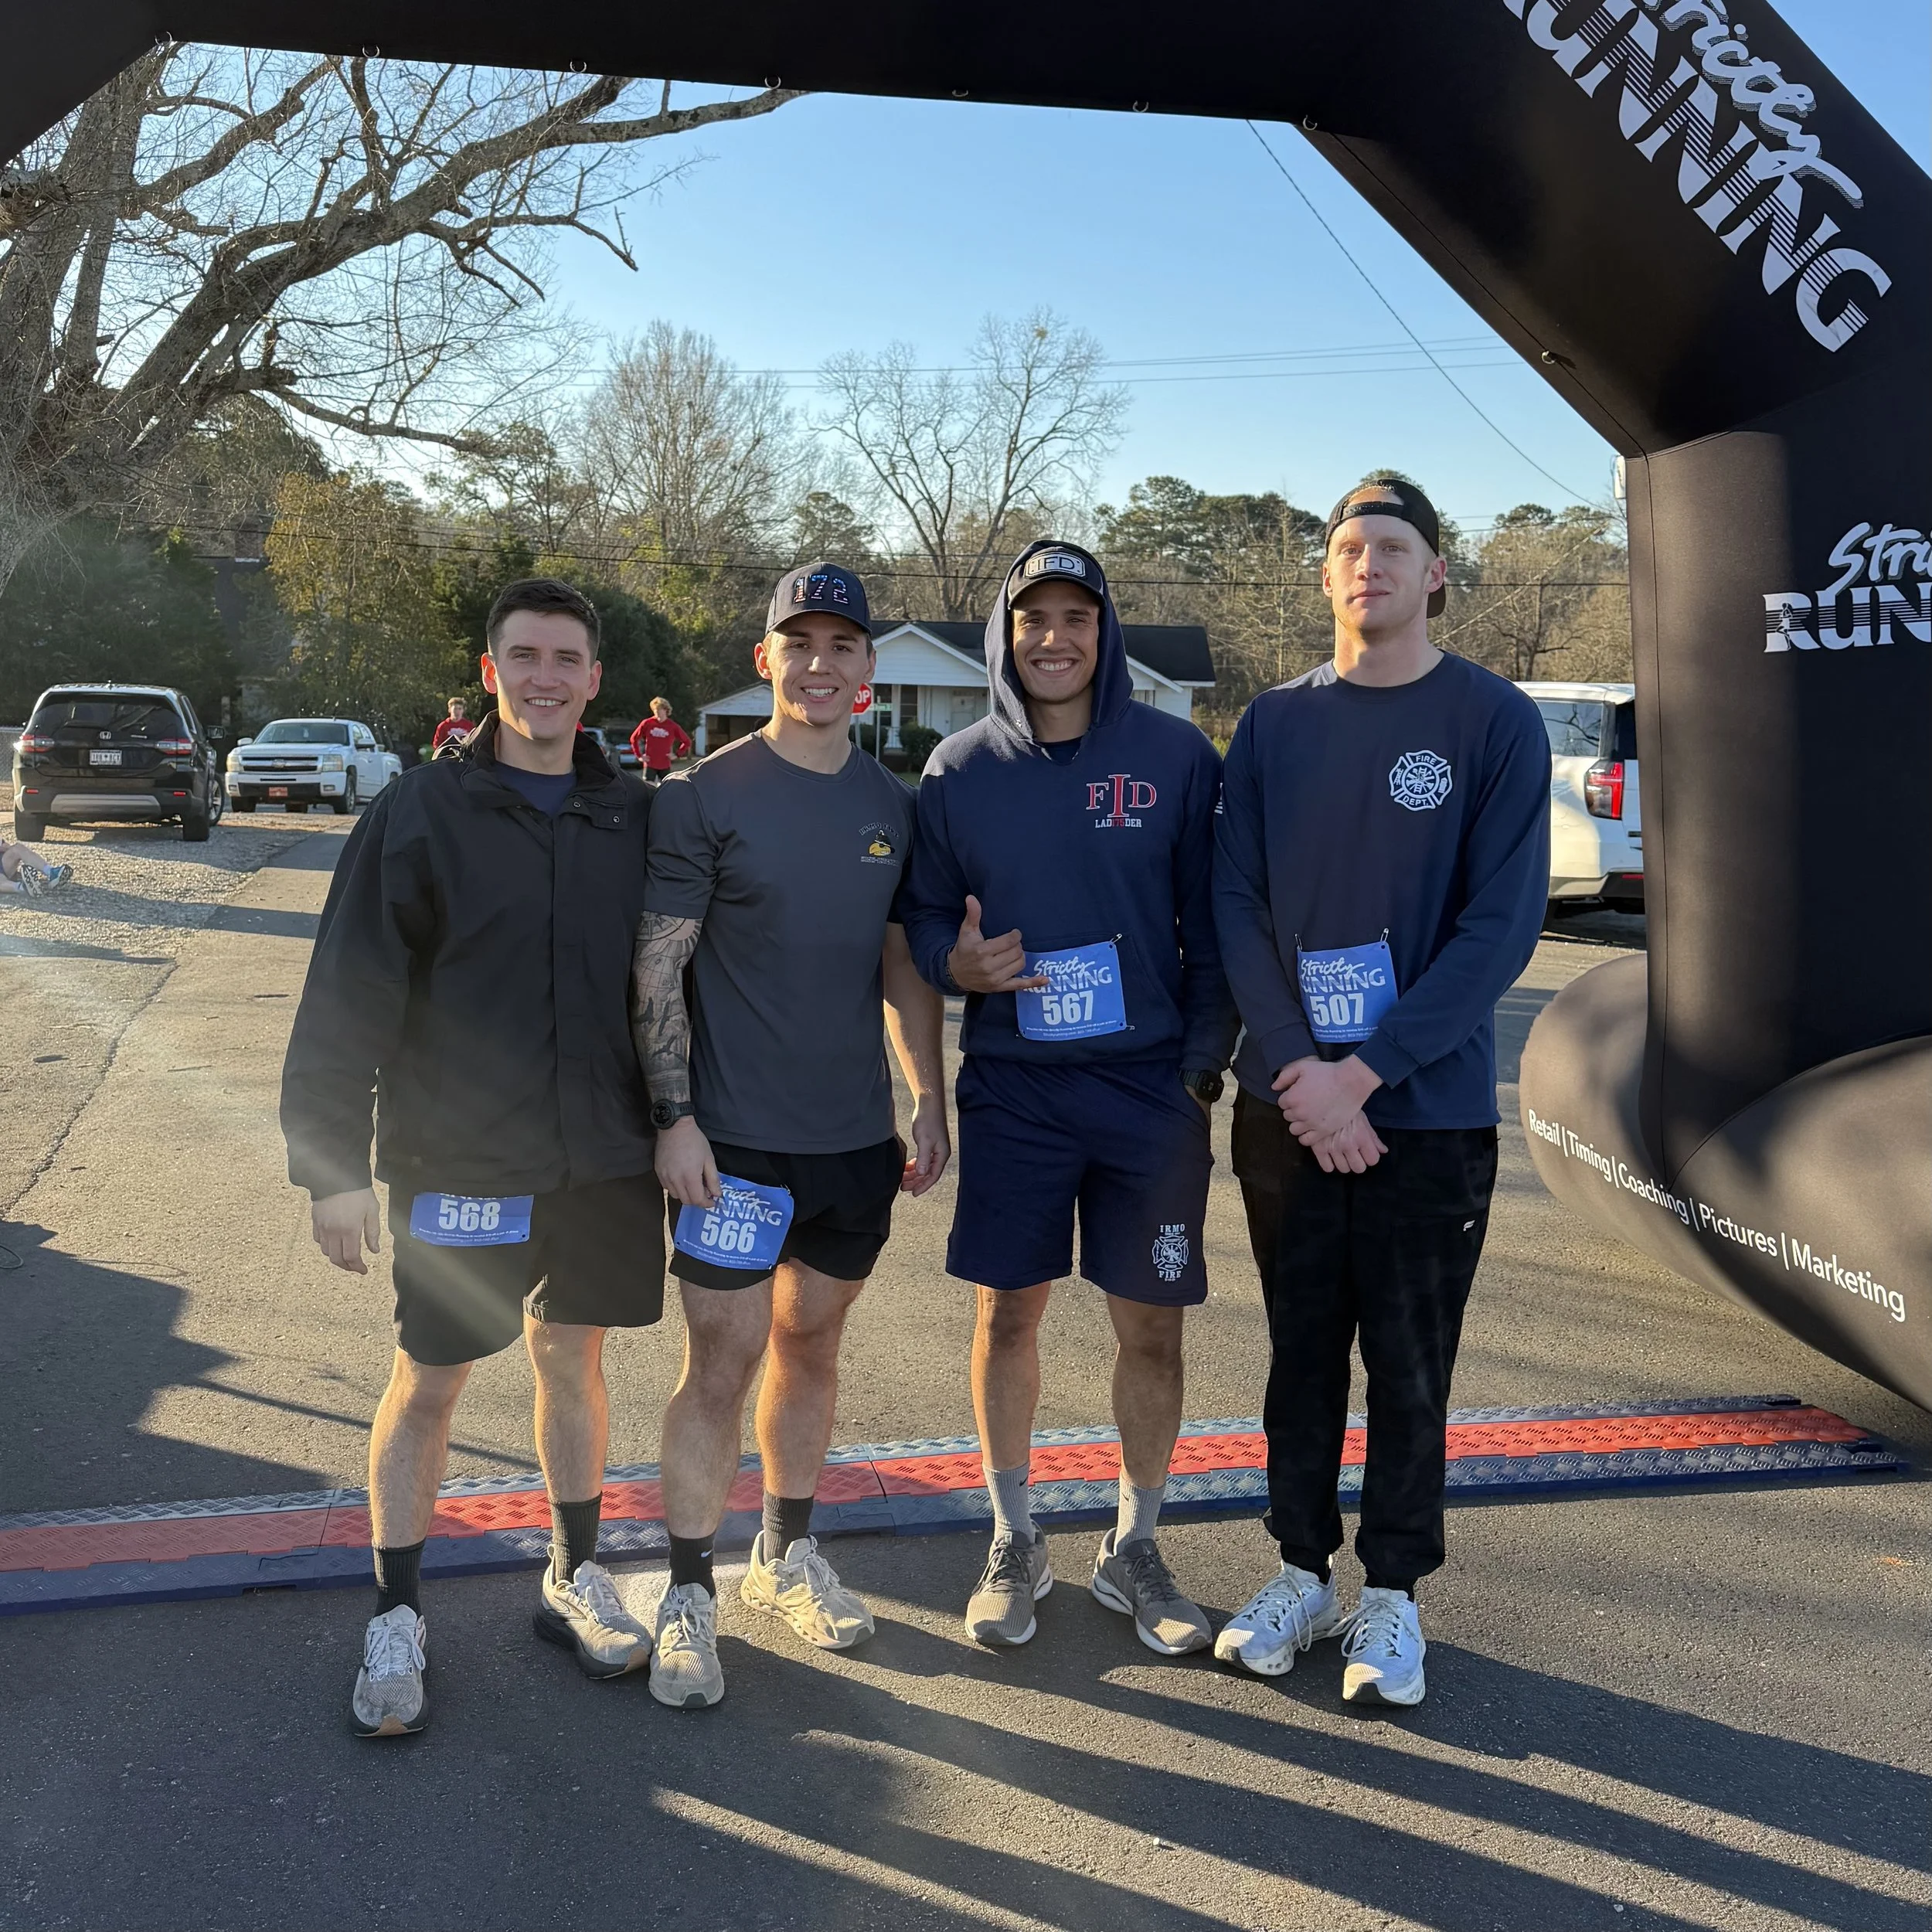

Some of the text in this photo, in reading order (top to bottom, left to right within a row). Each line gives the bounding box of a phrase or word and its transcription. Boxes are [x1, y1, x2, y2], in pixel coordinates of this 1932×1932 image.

[1503, 0, 1893, 352] UNNING
[1038, 556, 1075, 570] IFD
[1828, 522, 1932, 595] Stri
[793, 574, 849, 604] 172
[855, 689, 871, 704] OP
[1415, 755, 1437, 765] FIRE
[1403, 795, 1429, 805] DEPT.
[1022, 967, 1112, 994] NNING
[1034, 956, 1095, 977] Strictly
[1301, 957, 1365, 979] Strictly
[1301, 968, 1386, 993] UNNING
[1042, 990, 1094, 1026] 567
[1309, 992, 1364, 1026] 507
[439, 1199, 501, 1232] 568
[705, 1196, 782, 1226] NNING
[1528, 1109, 1560, 1147] Retail
[1567, 1130, 1611, 1182] Timing
[1618, 1162, 1689, 1226] Coaching
[1699, 1202, 1777, 1257] Pictures
[1791, 1238, 1906, 1323] Marketing
[701, 1214, 757, 1253] 566
[1160, 1223, 1185, 1233] IRMO
